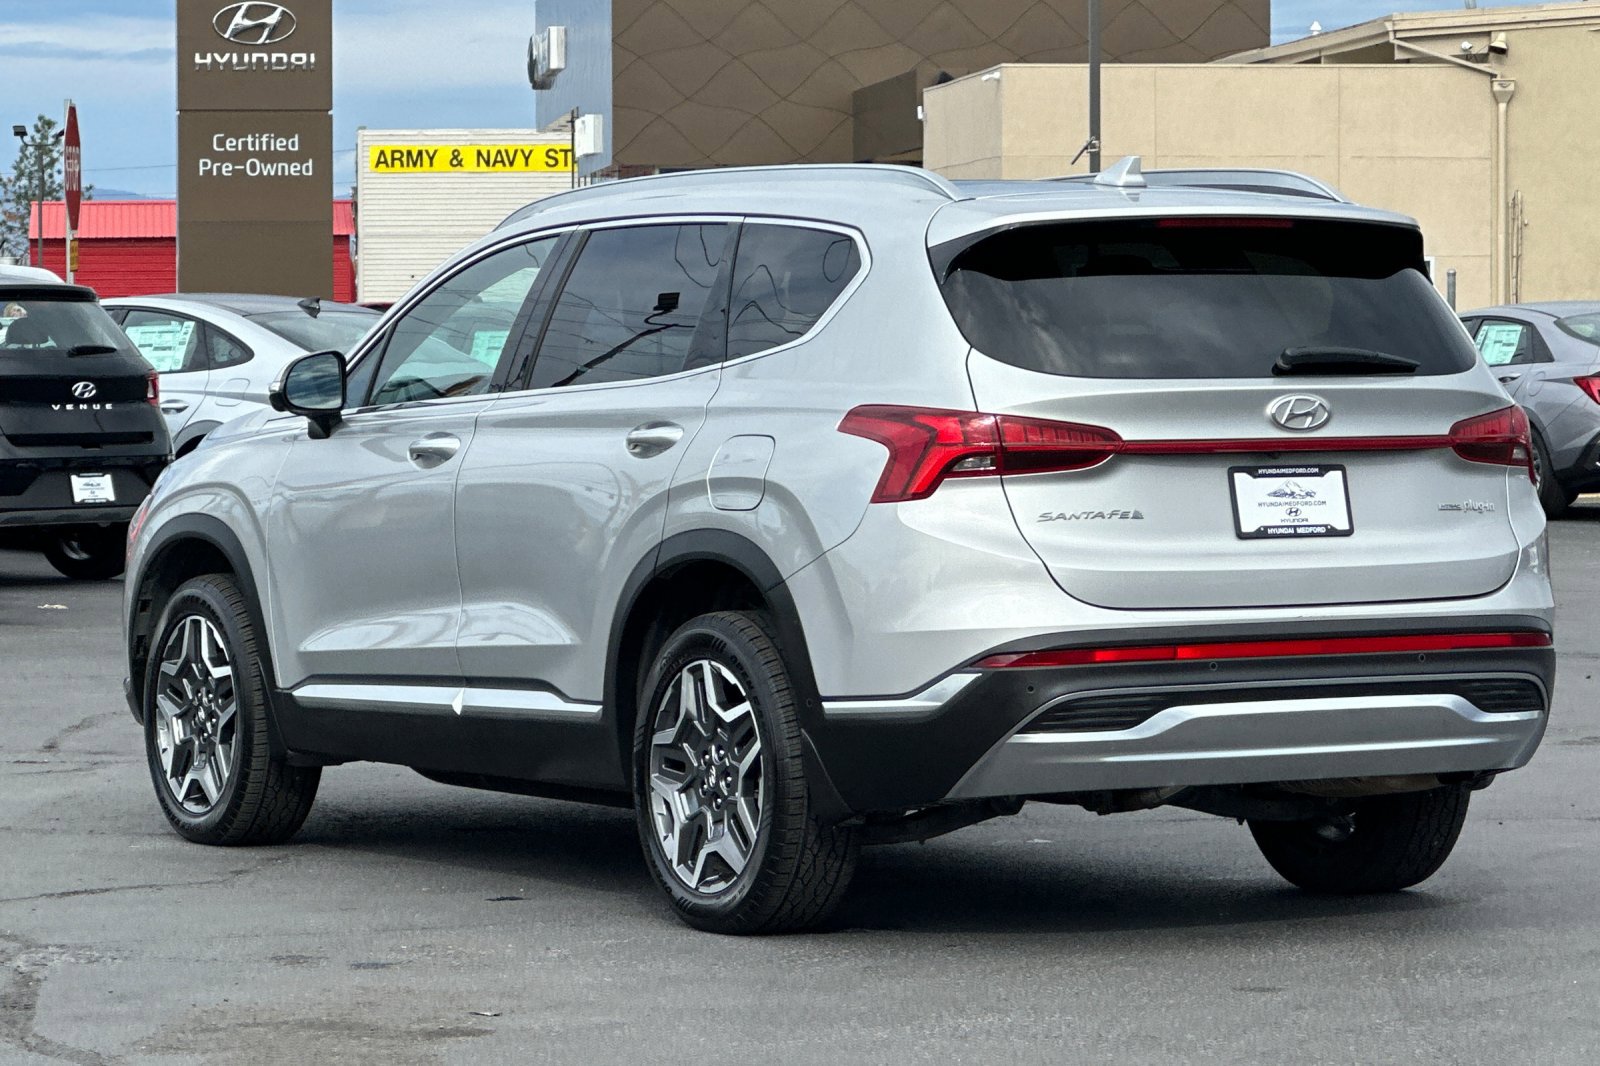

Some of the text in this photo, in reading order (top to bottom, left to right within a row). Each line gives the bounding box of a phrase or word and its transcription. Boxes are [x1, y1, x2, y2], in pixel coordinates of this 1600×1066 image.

[194, 52, 316, 71] HYUNDAI
[212, 133, 299, 151] Certified
[199, 158, 313, 176] Pre-Owned
[374, 149, 438, 168] ARMY
[449, 149, 464, 167] &
[476, 149, 533, 167] NAVY
[51, 403, 113, 411] VENUE
[1258, 467, 1319, 475] HYUNDAIMEDFORD.COM
[1296, 526, 1327, 534] MEDFORD
